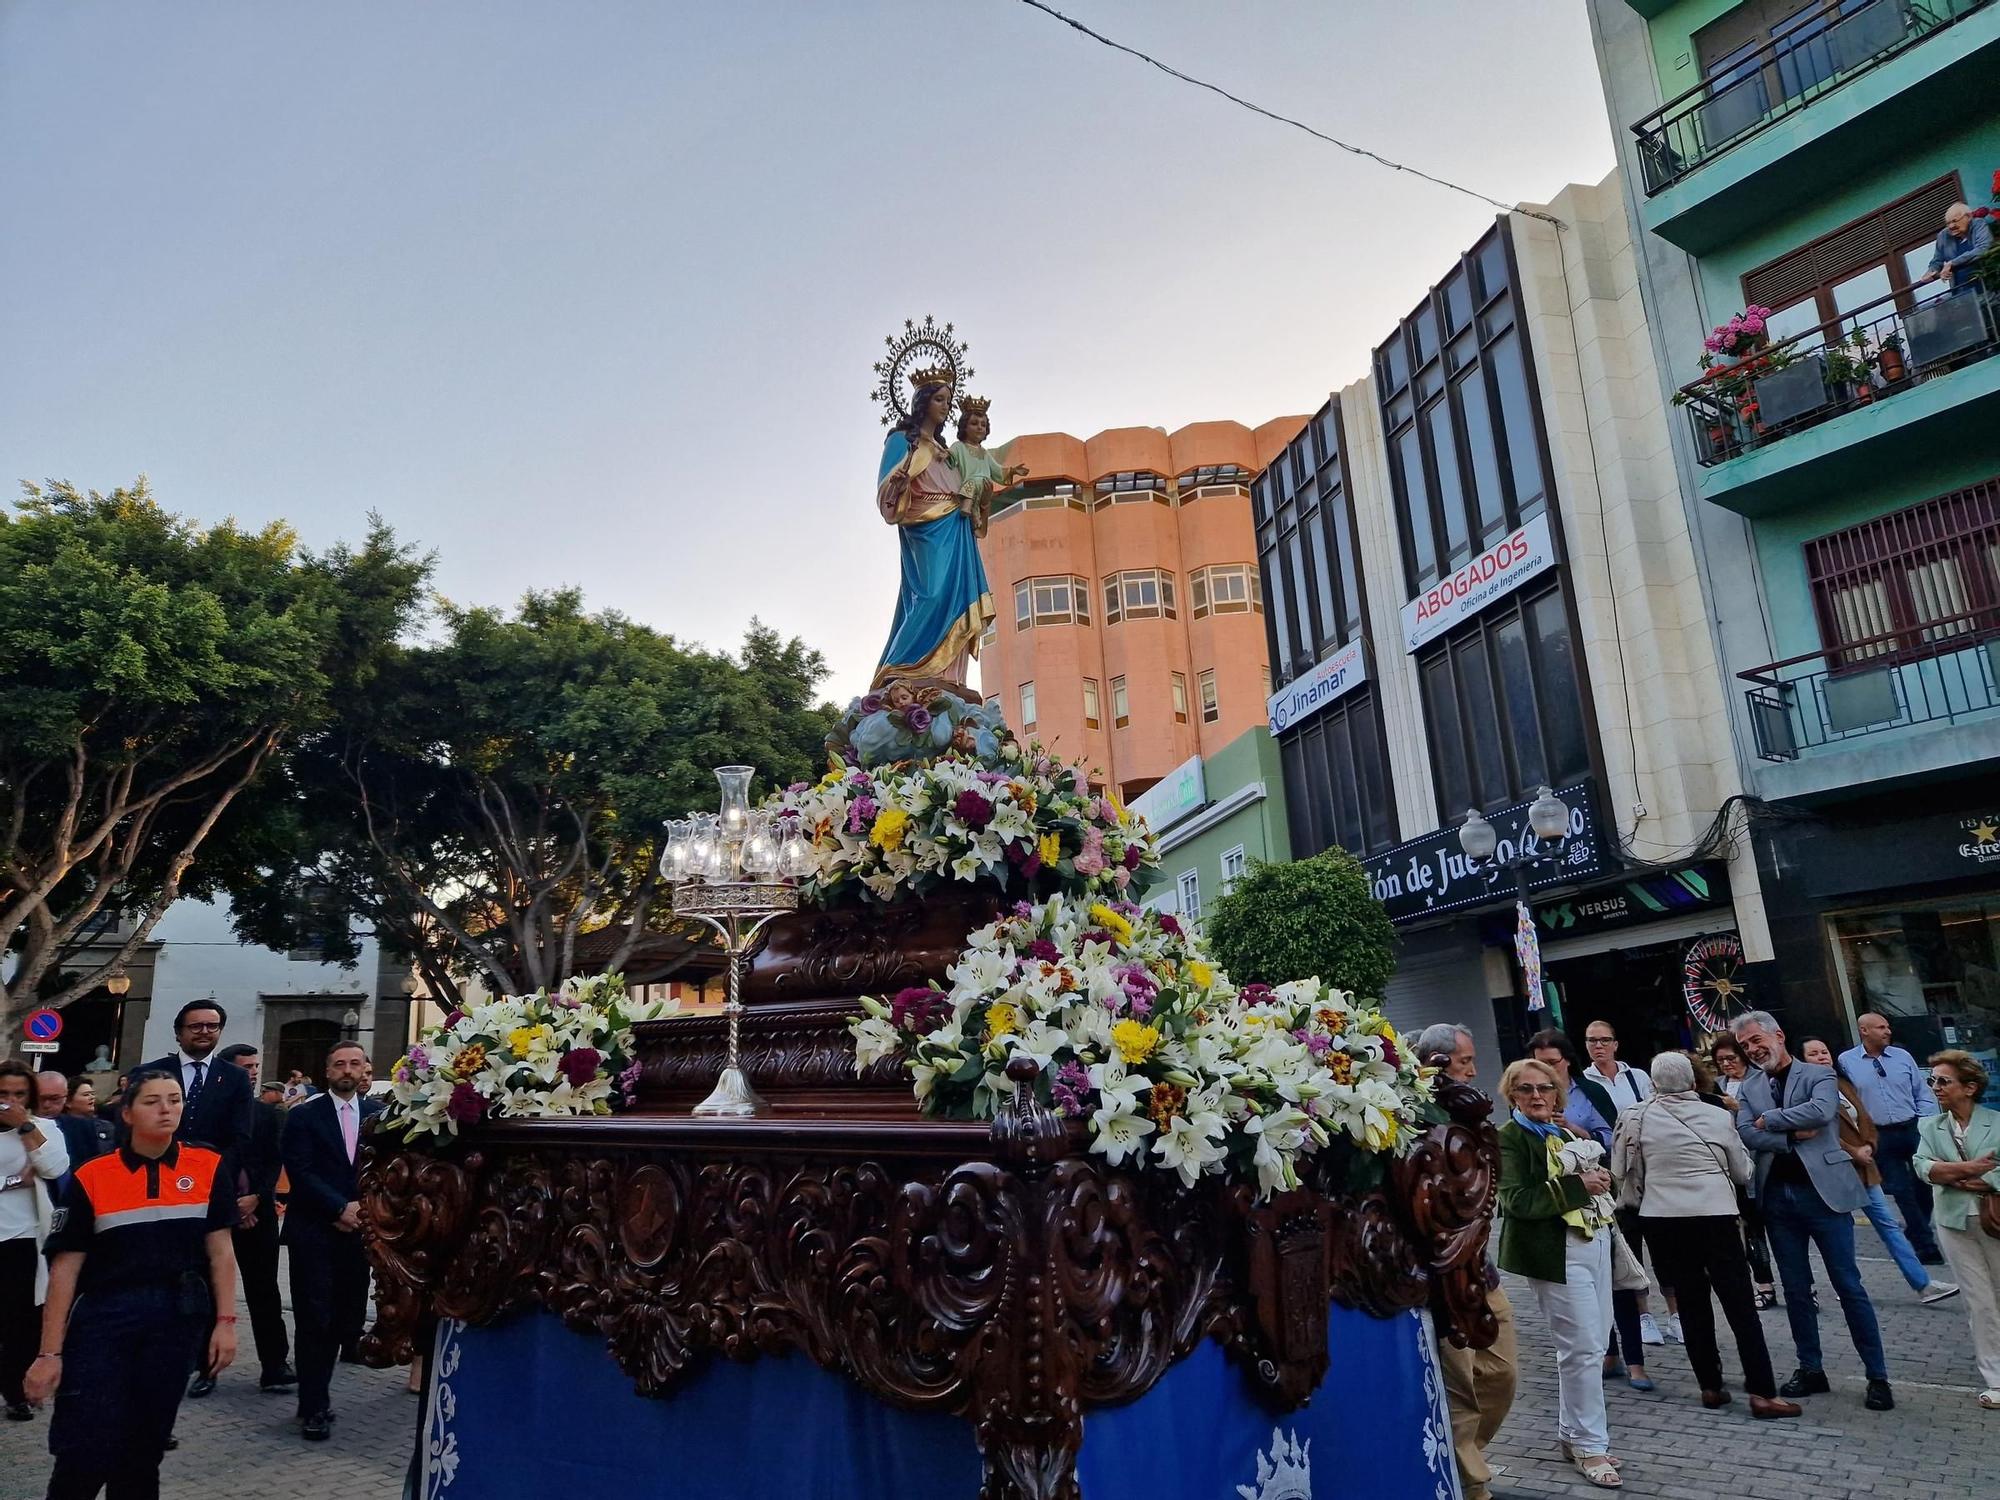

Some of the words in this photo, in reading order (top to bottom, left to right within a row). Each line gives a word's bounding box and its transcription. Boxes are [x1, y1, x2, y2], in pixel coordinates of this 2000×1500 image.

[1416, 531, 1529, 625] ABOGADOS
[1460, 590, 1488, 613] Oficina
[1488, 582, 1499, 595] de
[1500, 554, 1543, 589] Ingeniería
[1316, 648, 1358, 680] Autoescuela
[1290, 667, 1347, 717] Jinámar
[1567, 846, 1590, 866] RED
[1570, 839, 1585, 853] EN
[1959, 840, 2000, 858] Estre
[1406, 855, 1434, 893] de
[1436, 839, 1516, 896] Jueo
[1578, 896, 1627, 917] VERSUS
